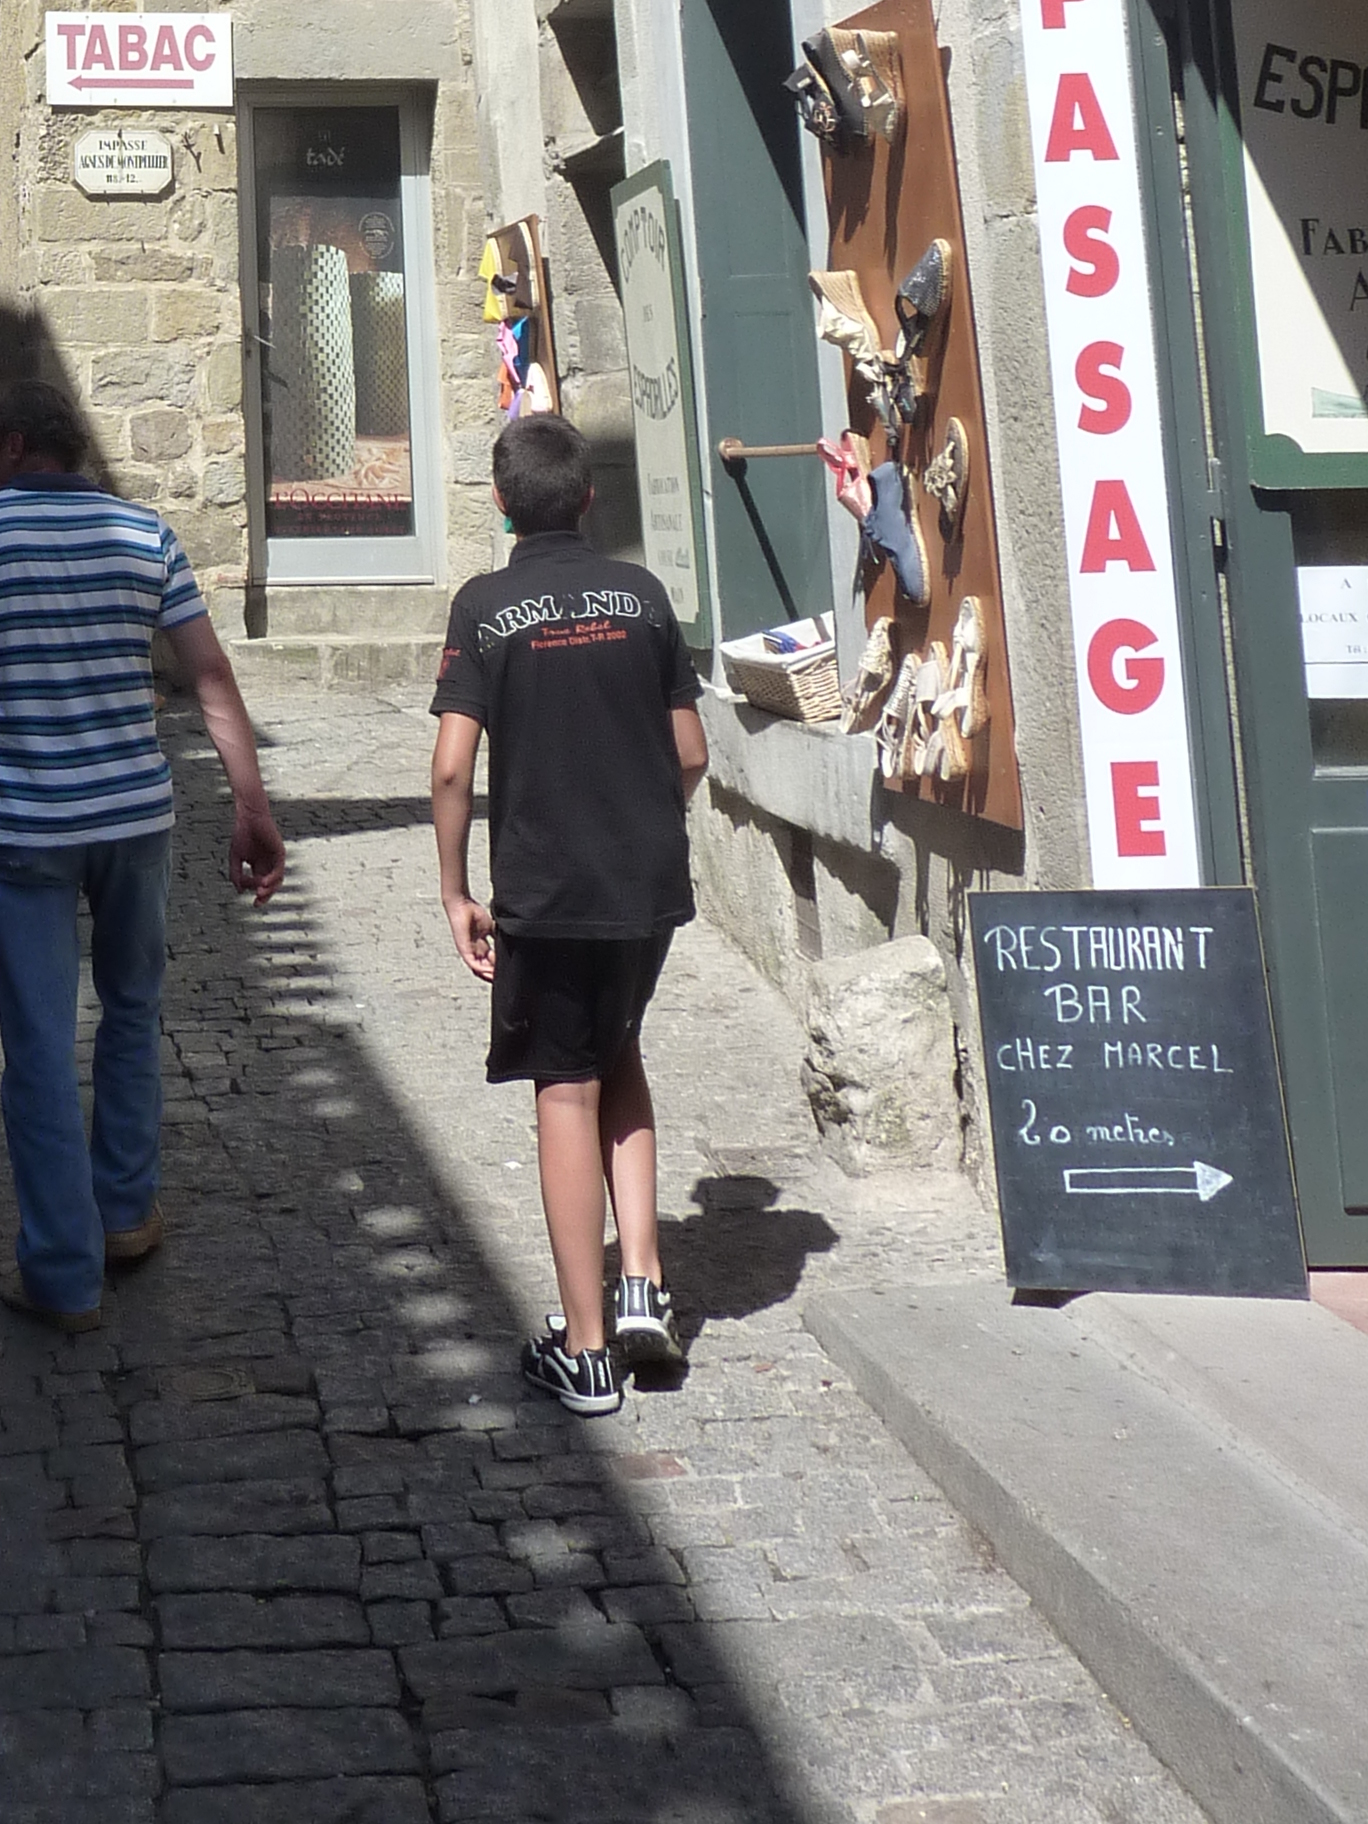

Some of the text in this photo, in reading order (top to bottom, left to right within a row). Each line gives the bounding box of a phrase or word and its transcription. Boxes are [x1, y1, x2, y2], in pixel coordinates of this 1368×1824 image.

[57, 23, 216, 72] TABAC
[98, 139, 148, 152] IMPASSE
[117, 154, 169, 170] MONTPELLIER
[274, 488, 408, 510] L'OCCITANE
[1302, 612, 1359, 624] LOCAUX
[983, 925, 1214, 972] RESTAURANT
[1043, 982, 1147, 1025] BAR
[996, 1037, 1234, 1073] CHEZ MARCEL
